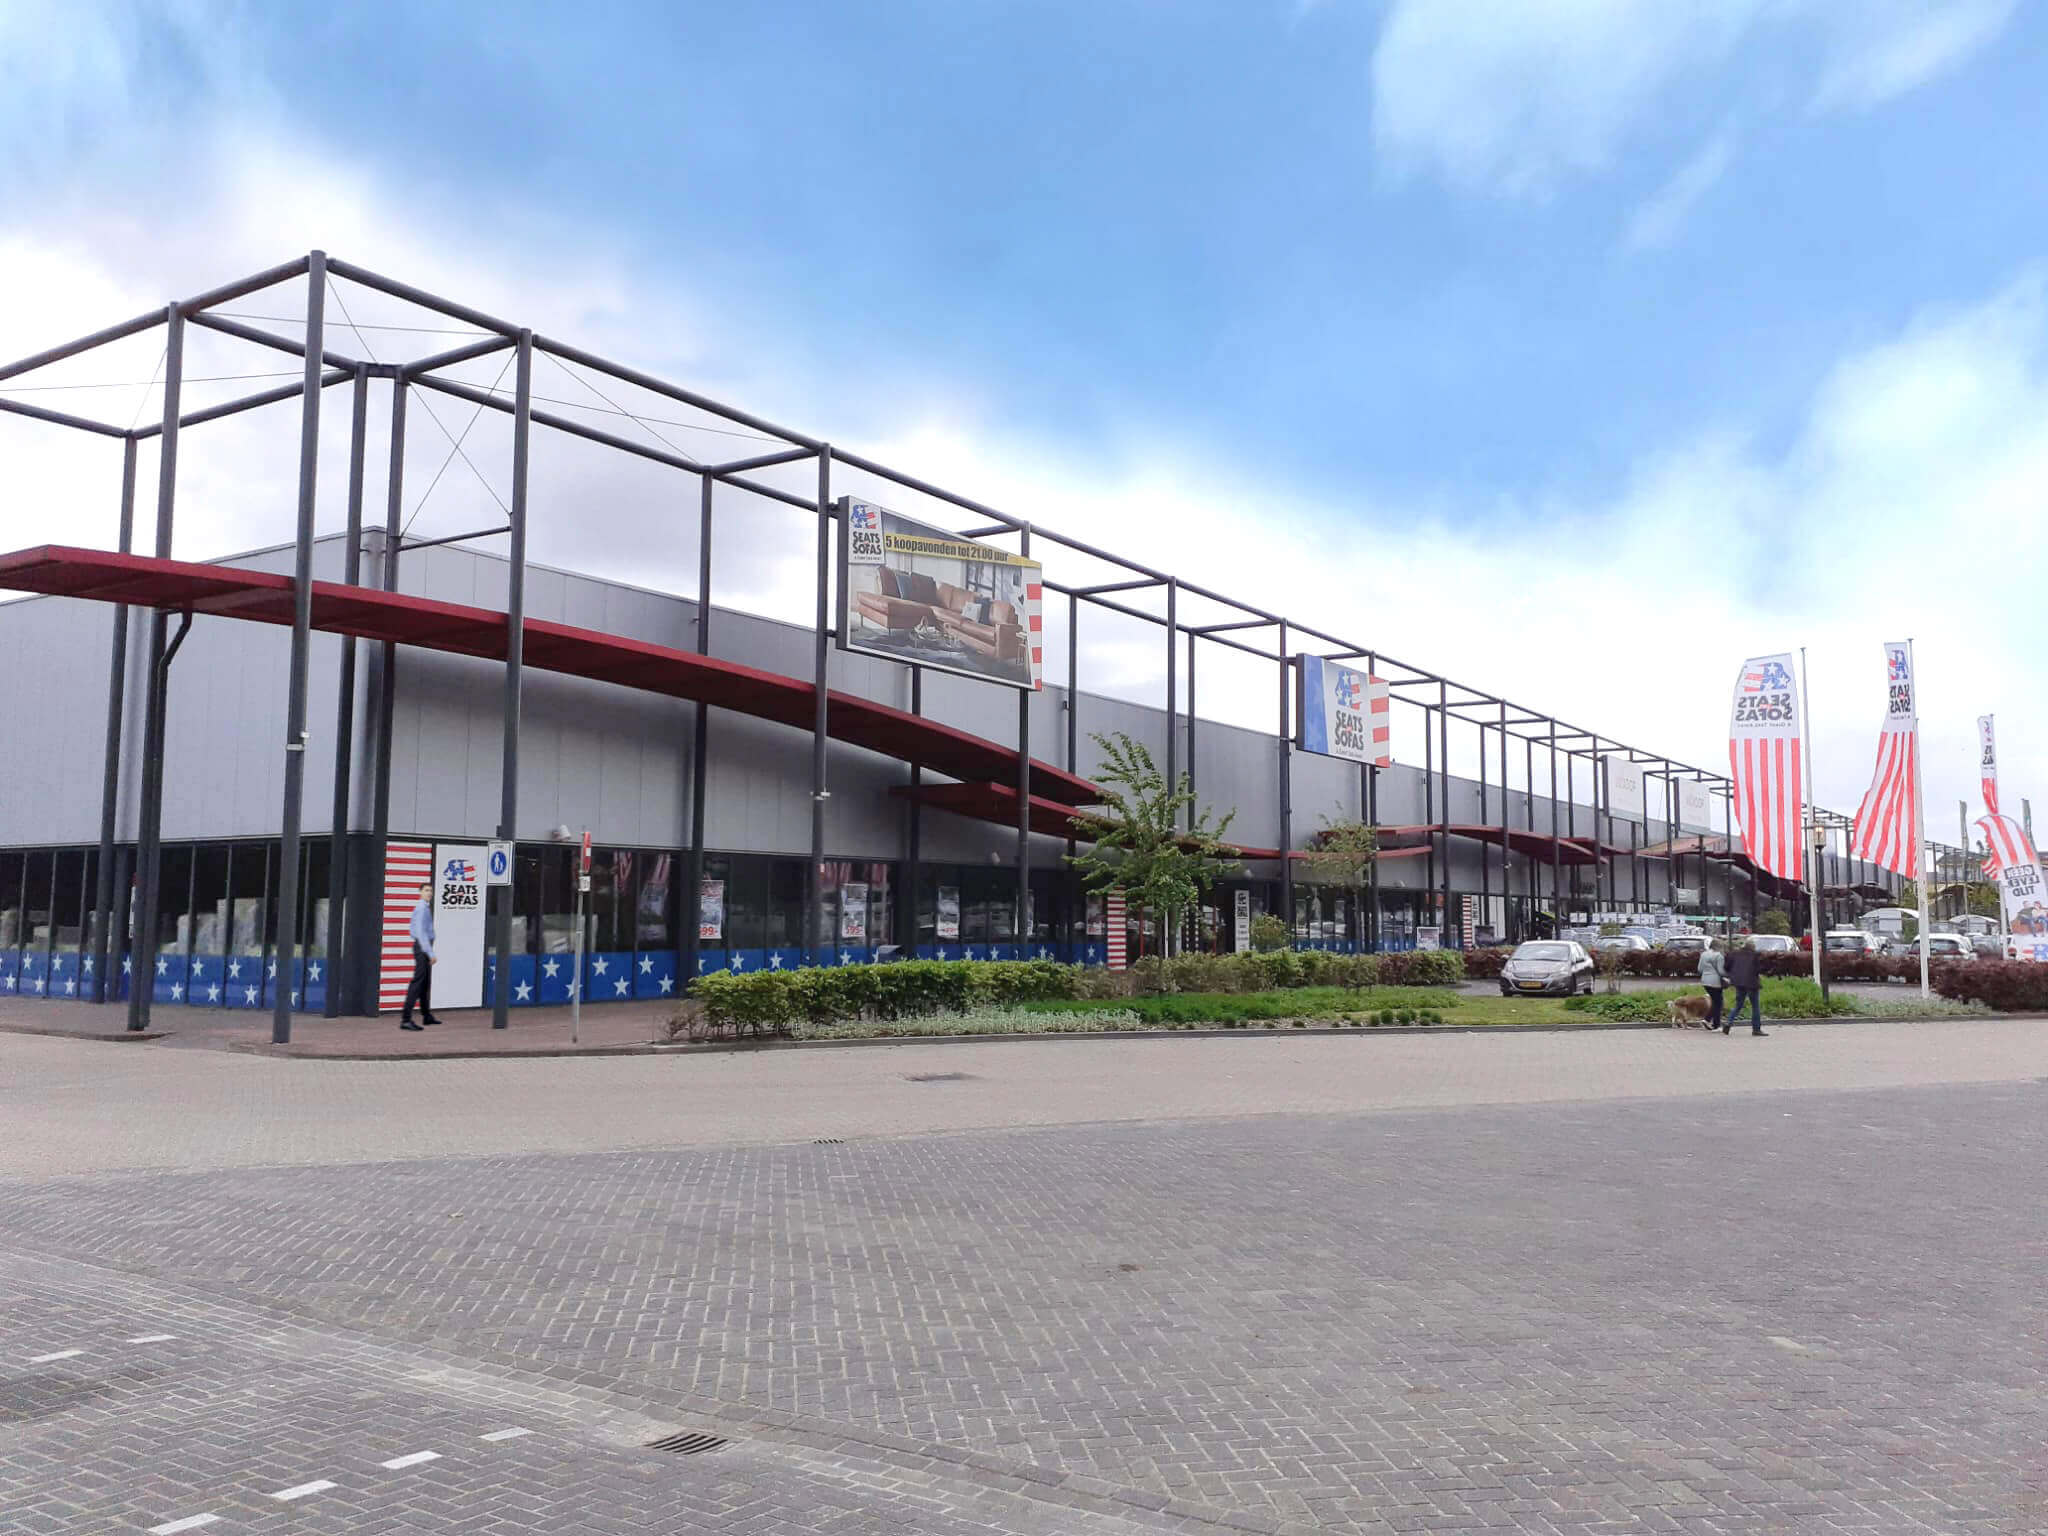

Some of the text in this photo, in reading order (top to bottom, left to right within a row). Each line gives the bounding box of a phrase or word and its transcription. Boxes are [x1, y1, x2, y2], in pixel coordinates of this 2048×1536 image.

[852, 531, 880, 544] SEATS
[852, 543, 882, 556] SOFAS
[885, 535, 892, 548] 5
[894, 536, 956, 556] koopavonden
[958, 545, 969, 558] tot
[1335, 709, 1363, 732] SEATS
[1335, 728, 1364, 751] SOFAS
[444, 883, 478, 896] SEATS
[441, 894, 478, 905] SOFAS
